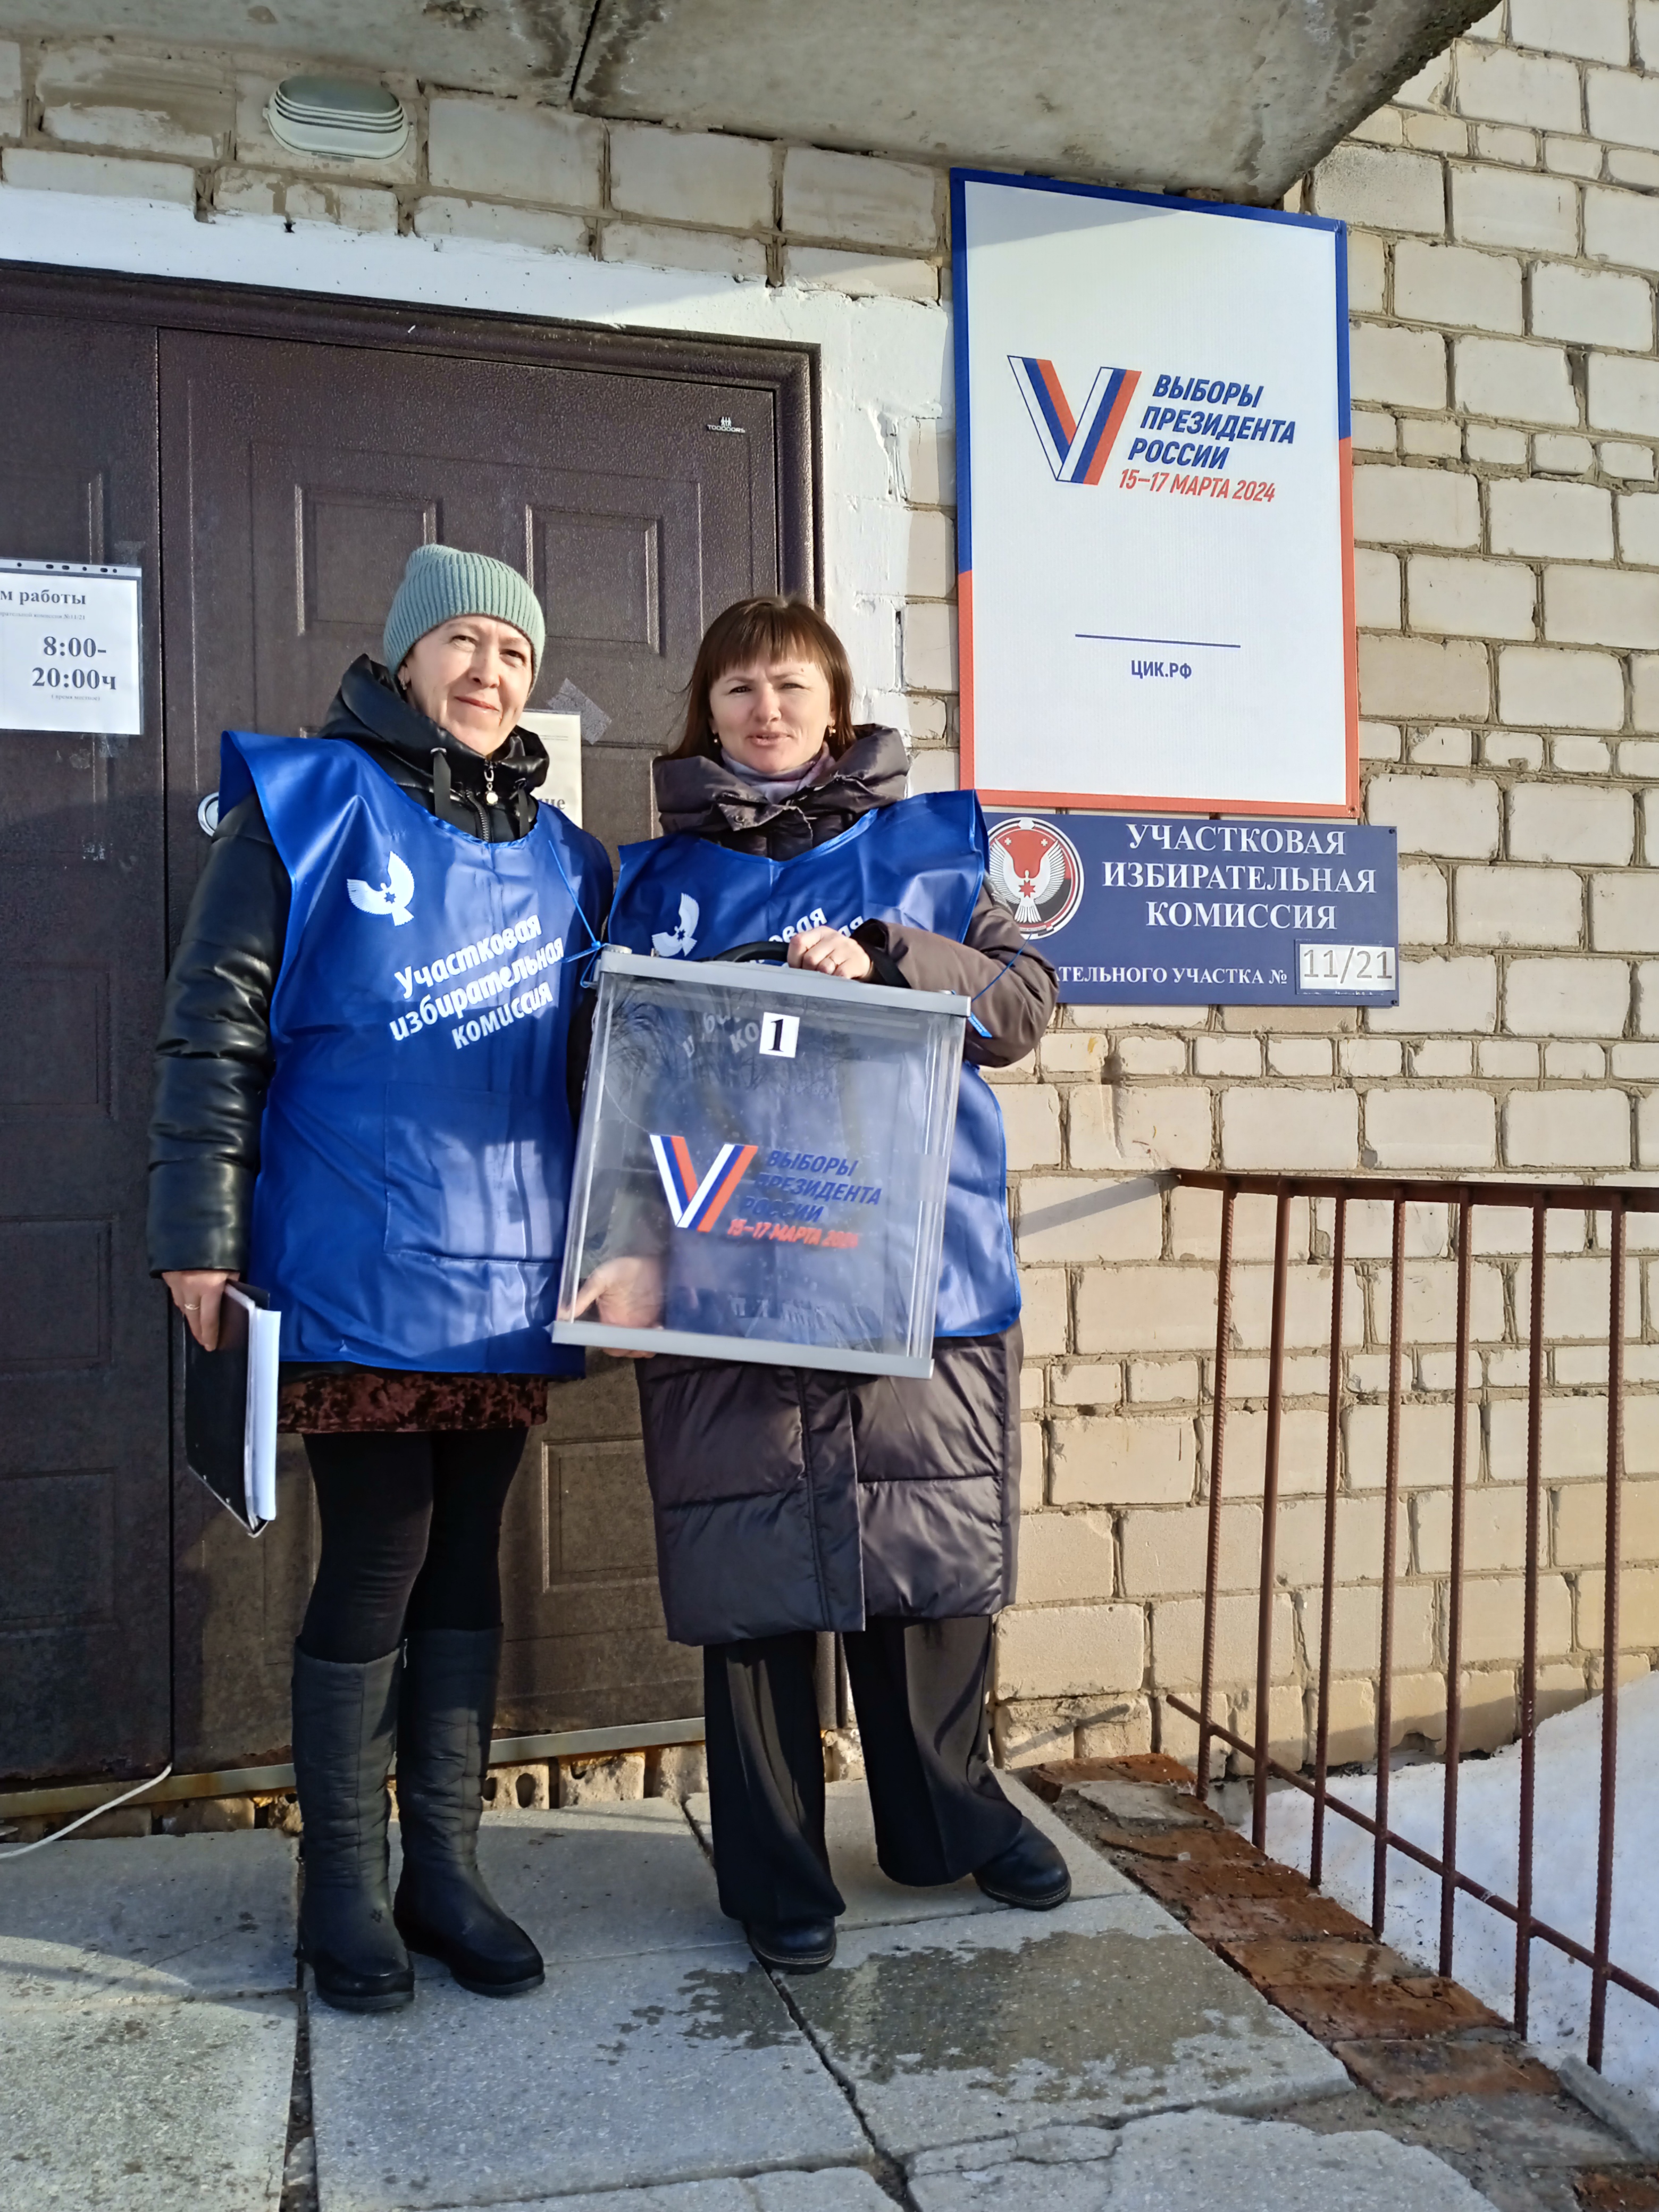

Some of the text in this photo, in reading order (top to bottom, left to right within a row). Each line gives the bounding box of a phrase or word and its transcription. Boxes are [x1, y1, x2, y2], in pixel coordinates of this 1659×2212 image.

[1152, 374, 1264, 408] ВЫБОРЫ
[1140, 406, 1296, 444] ПРЕЗИДЕНТА
[1128, 438, 1230, 470] РОССИИ
[1170, 473, 1230, 498] МАРТА
[1233, 480, 1276, 502] 2024
[19, 589, 86, 605] работы
[43, 636, 106, 657] 8:00-
[32, 667, 116, 690] 20:00ч
[1131, 660, 1192, 679] ЦИК.РФ
[1126, 824, 1346, 855] УЧАСТКОВАЯ
[1102, 861, 1376, 893] ИЗБИРАТЕЛЬНАЯ
[1145, 901, 1337, 930] КОМИССИЯ
[394, 914, 542, 999] Участковая
[1056, 947, 1393, 985] ТЕЛЬНОГО УЧАСТКА № 11/21
[389, 937, 564, 1041] избирательная
[451, 981, 553, 1050] комиссия
[768, 1018, 784, 1052] 1
[766, 1150, 859, 1177] ВЫБОРЫ
[754, 1172, 882, 1205] ПРЕЗИДЕНТА
[740, 1196, 825, 1223] РОССИИ
[769, 1224, 823, 1246] МАРТА
